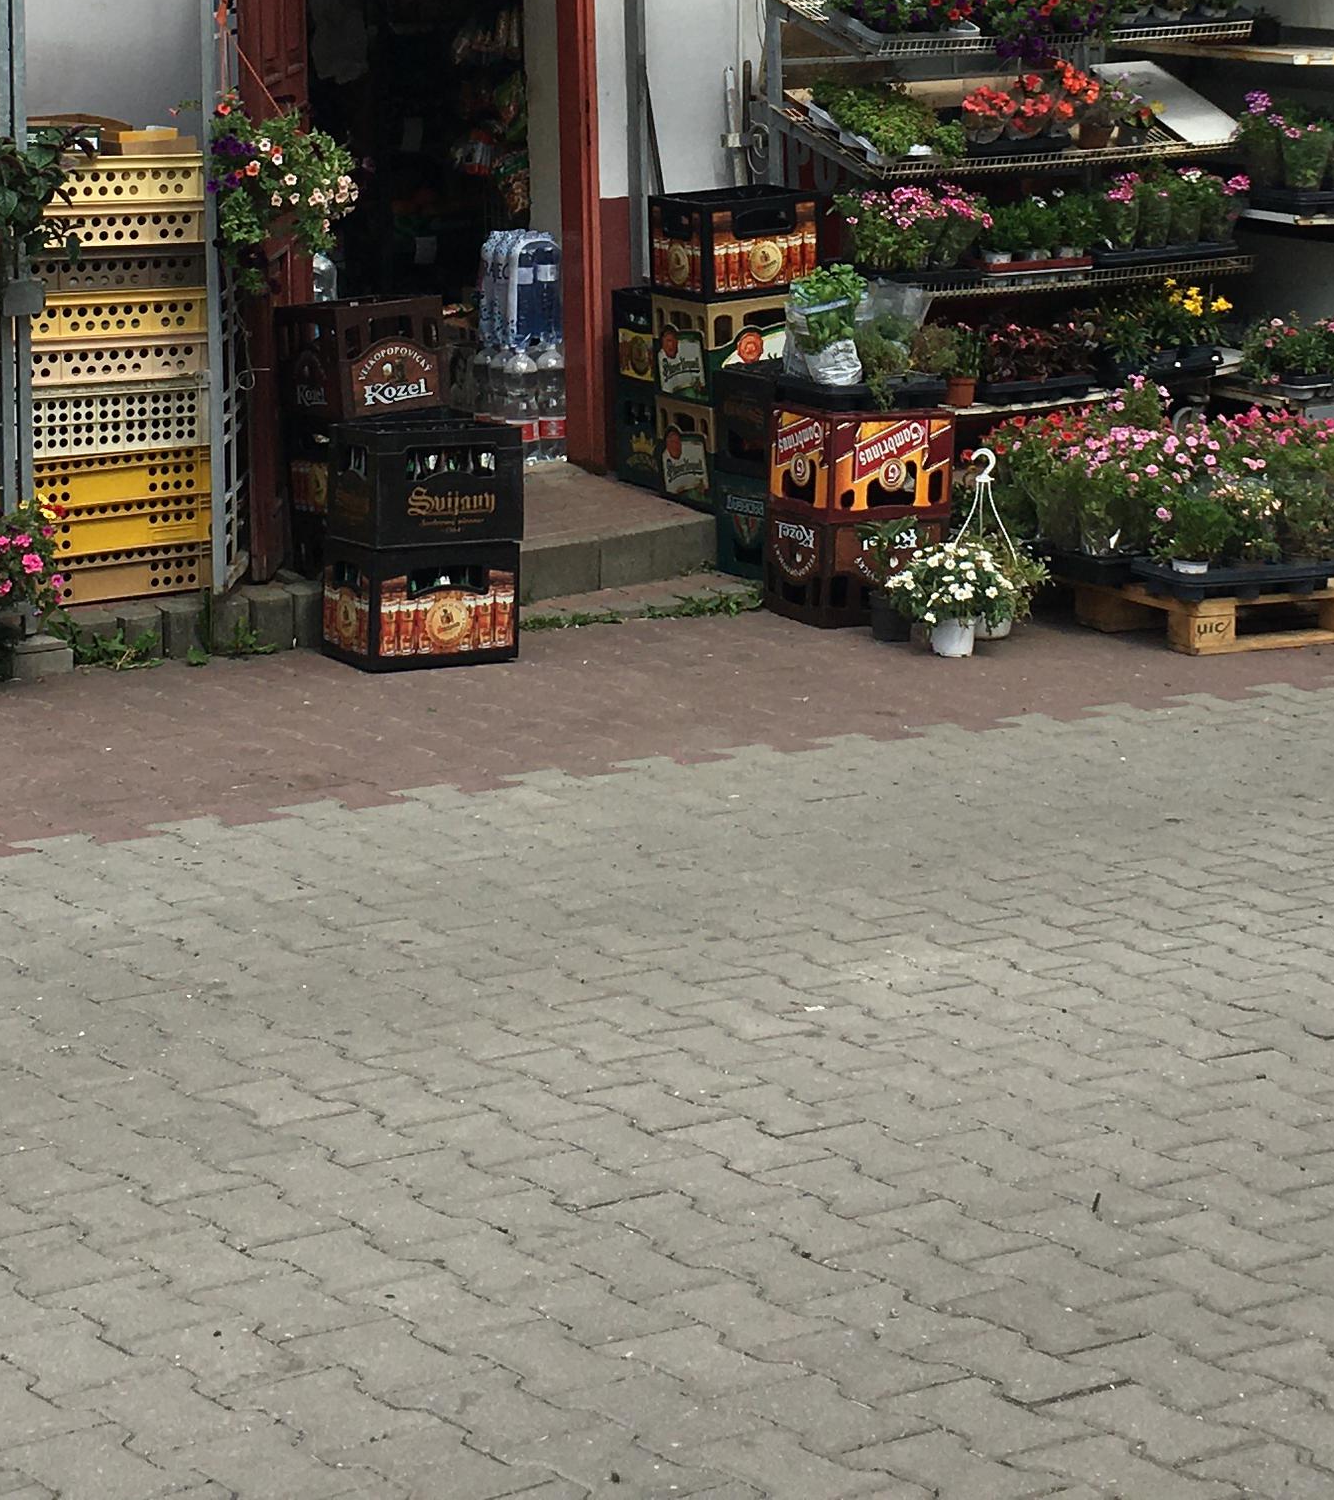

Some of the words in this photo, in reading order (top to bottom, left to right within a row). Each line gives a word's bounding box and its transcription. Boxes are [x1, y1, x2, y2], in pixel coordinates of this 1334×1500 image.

[364, 378, 434, 407] Kozel
[858, 421, 926, 466] Gambrinus
[407, 486, 496, 516] Svijany
[774, 520, 815, 549] Kozel
